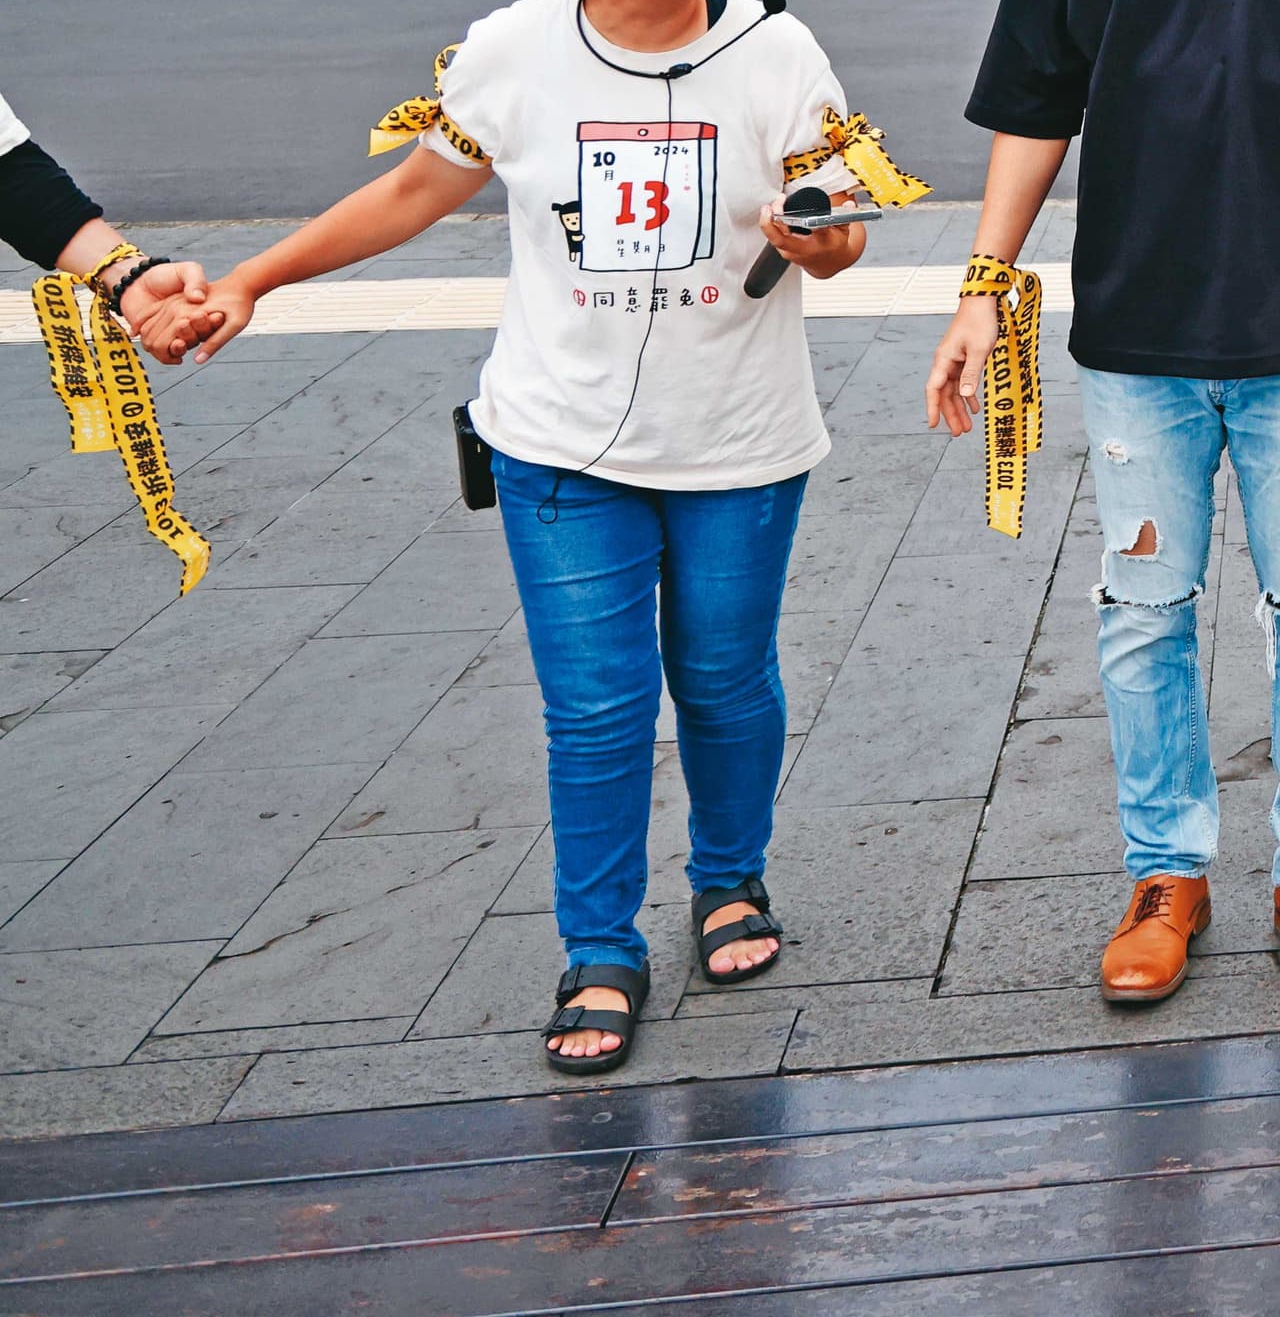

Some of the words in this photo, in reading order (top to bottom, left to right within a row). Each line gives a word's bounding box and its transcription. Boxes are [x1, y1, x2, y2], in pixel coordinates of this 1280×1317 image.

[593, 151, 616, 168] 10
[653, 145, 690, 157] 2024
[604, 170, 614, 182] 月
[615, 180, 670, 231] 13
[593, 286, 695, 314] 同意罷免
[109, 348, 139, 397] 1013
[996, 460, 1014, 491] 1013
